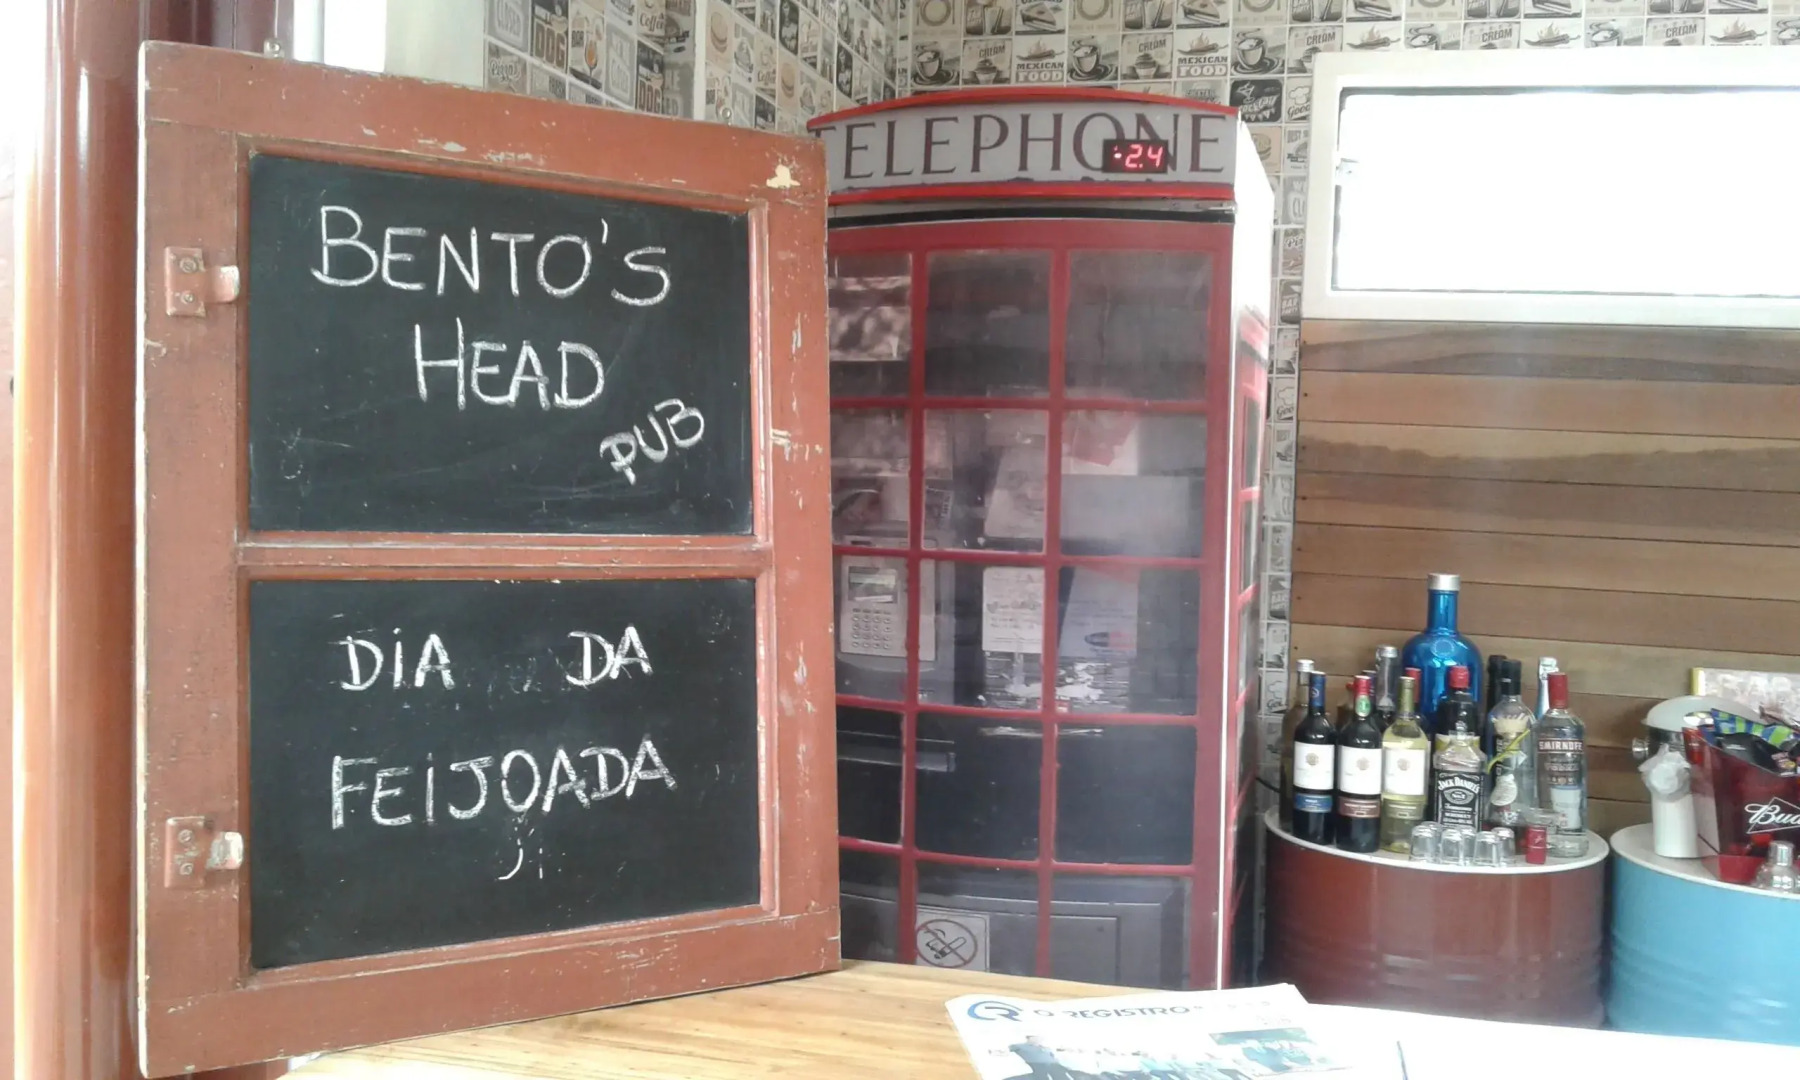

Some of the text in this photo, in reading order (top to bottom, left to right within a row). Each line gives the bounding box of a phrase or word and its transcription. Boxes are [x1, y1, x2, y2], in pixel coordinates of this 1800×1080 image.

[1017, 62, 1065, 70] MEXICAN
[1018, 71, 1063, 82] FOOD
[1178, 56, 1229, 64] MEXICAN
[1179, 66, 1228, 77] FOOD
[310, 204, 672, 307] BENTO'S
[414, 316, 606, 412] HEAD
[599, 398, 706, 486] PUB
[564, 623, 654, 687] DA
